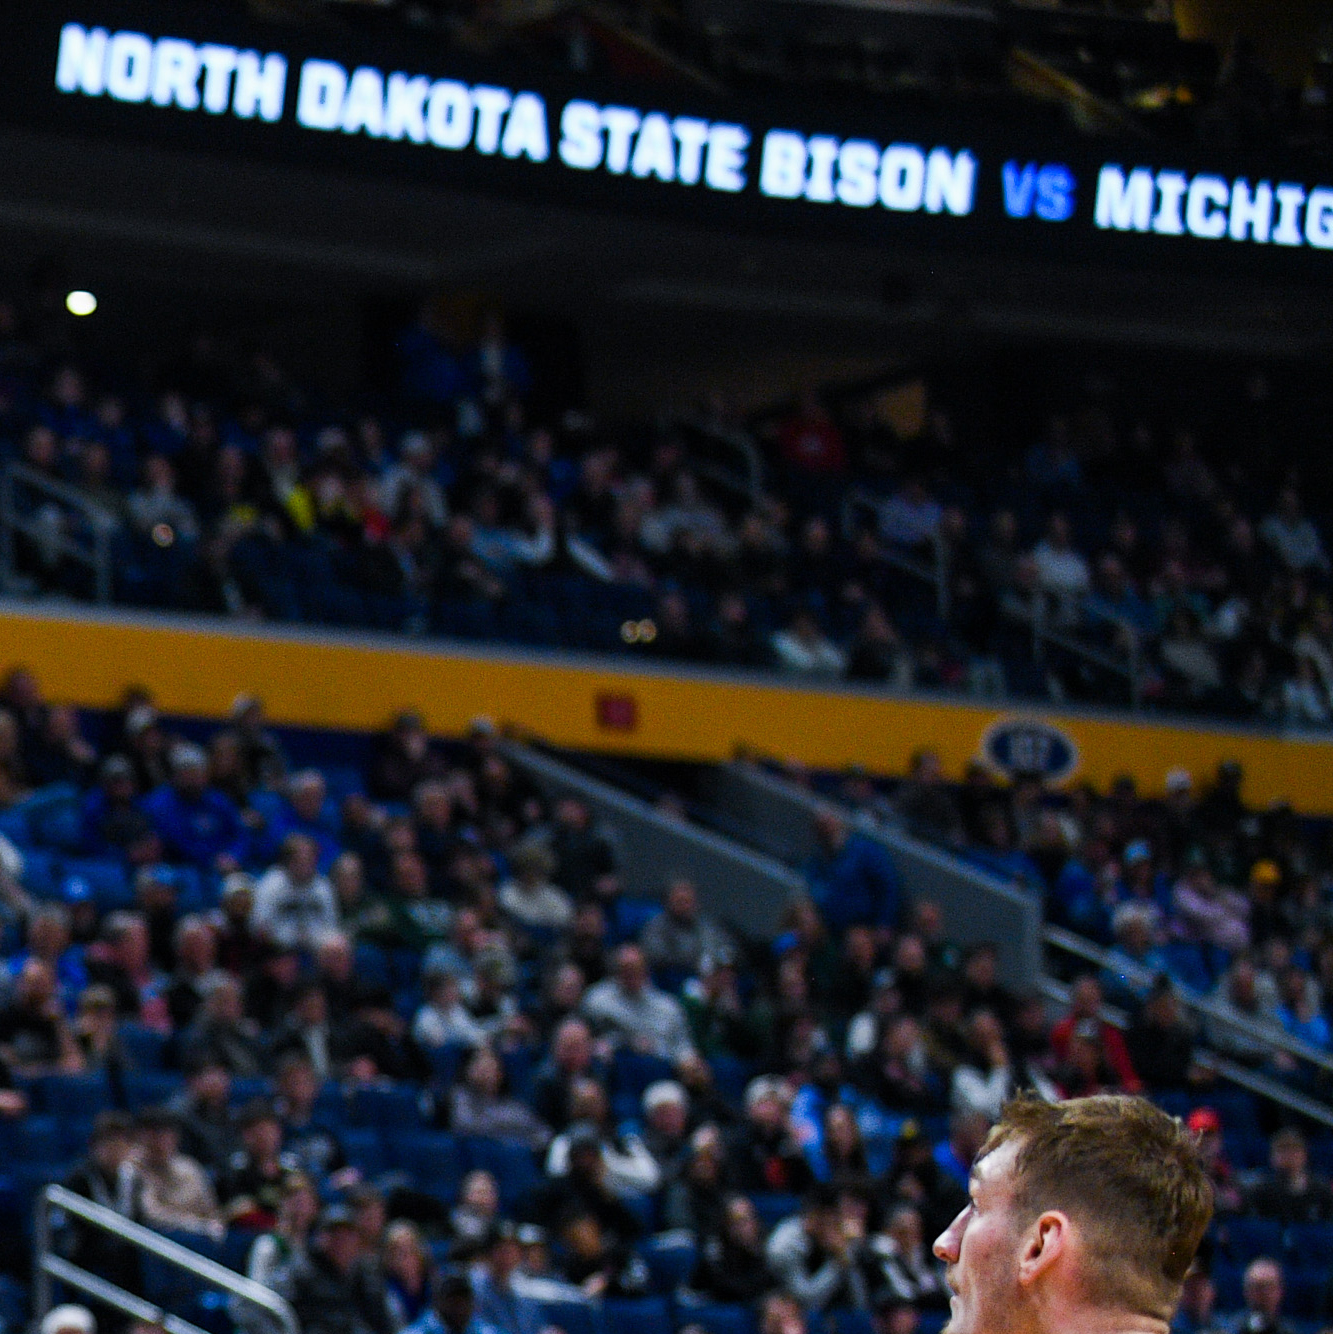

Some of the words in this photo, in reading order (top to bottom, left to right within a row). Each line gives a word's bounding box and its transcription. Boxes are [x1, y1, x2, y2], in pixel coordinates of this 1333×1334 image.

[55, 22, 288, 123] NORTH
[296, 57, 550, 163] DAKOTA
[559, 100, 751, 193] STATE
[759, 128, 976, 216] BISON
[1002, 160, 1076, 221] VS
[1094, 162, 1333, 249] MICHIG
